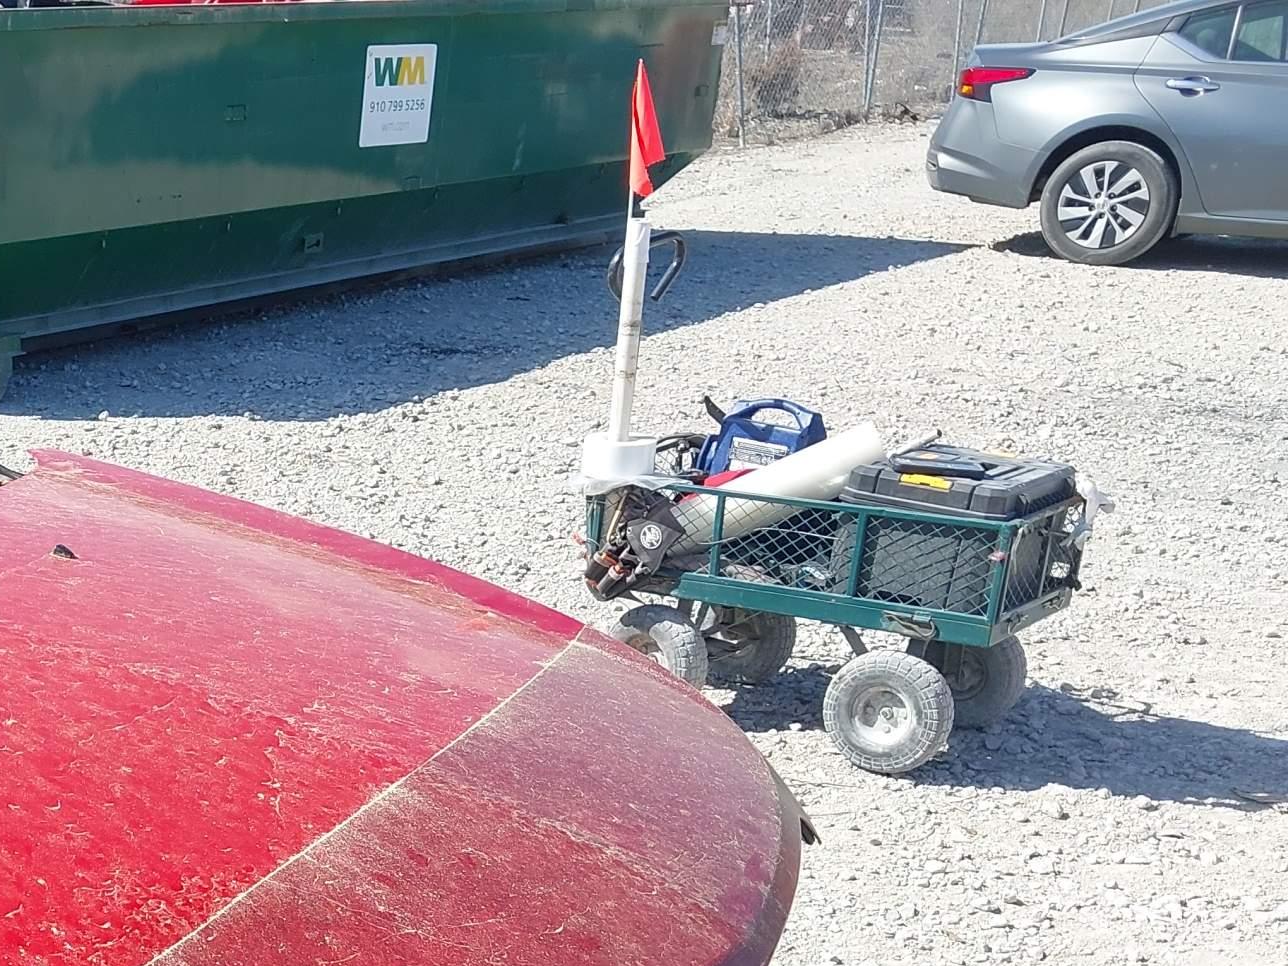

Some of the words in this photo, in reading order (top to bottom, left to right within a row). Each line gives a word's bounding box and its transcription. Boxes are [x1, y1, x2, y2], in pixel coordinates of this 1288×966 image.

[374, 56, 425, 87] WM
[369, 101, 386, 113] 910
[388, 100, 403, 112] 799
[405, 98, 425, 111] 5256
